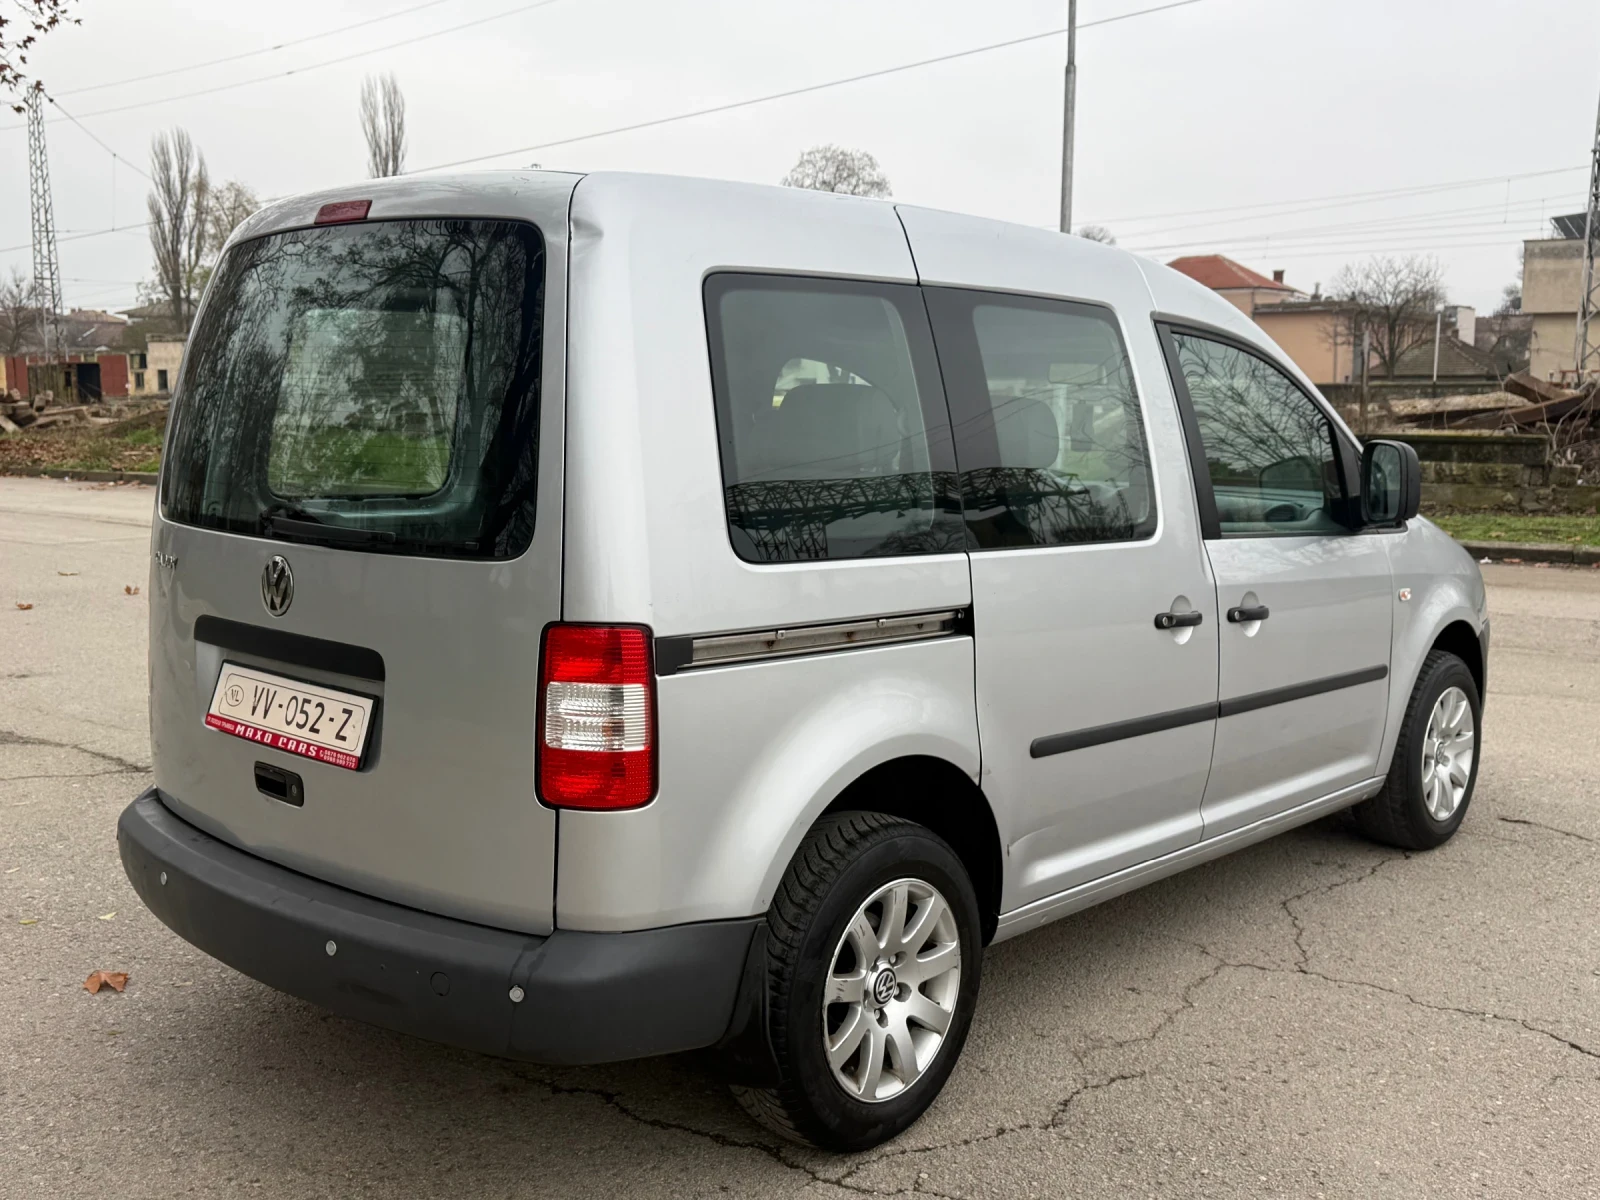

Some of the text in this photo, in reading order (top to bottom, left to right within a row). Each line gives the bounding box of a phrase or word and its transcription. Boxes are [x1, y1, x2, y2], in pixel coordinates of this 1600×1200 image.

[250, 685, 354, 742] VV-052-Z
[235, 724, 318, 758] MAXO CARS
